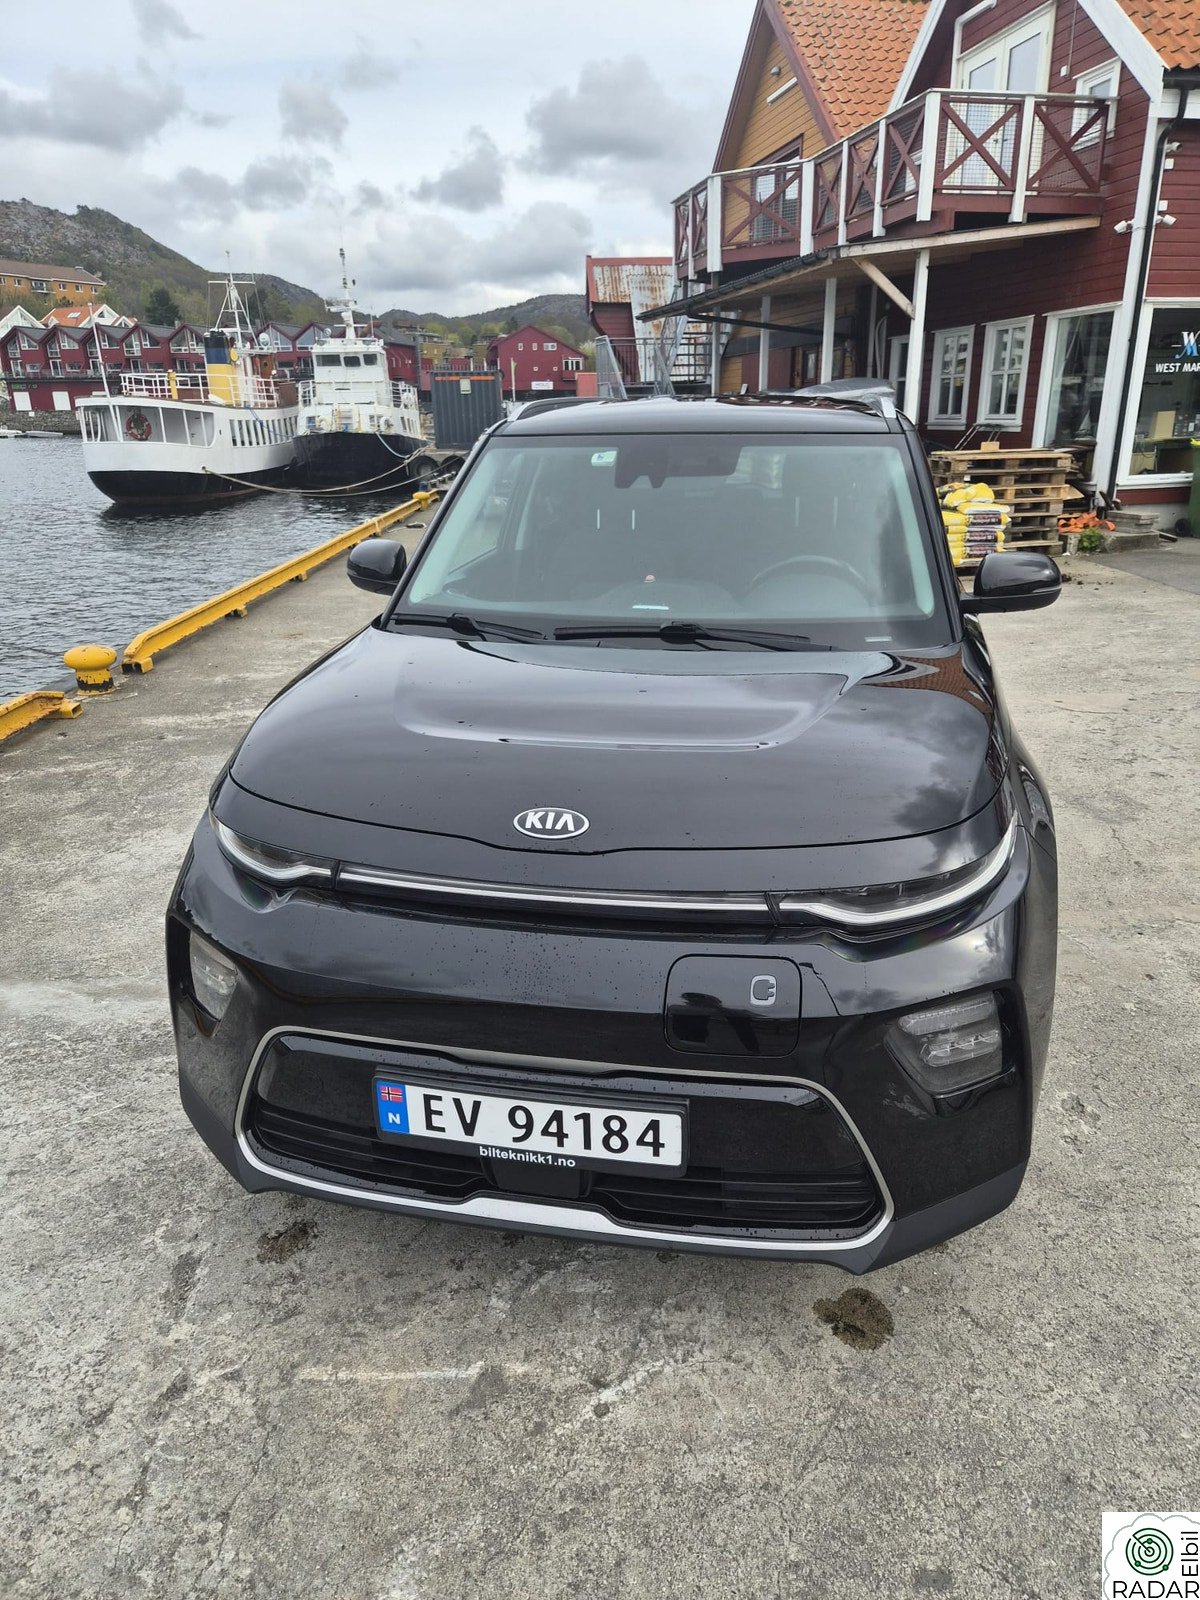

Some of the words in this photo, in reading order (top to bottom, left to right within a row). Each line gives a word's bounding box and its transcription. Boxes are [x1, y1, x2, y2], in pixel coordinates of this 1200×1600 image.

[1155, 363, 1181, 373] WEST
[525, 811, 575, 832] KIA
[387, 1112, 401, 1125] N
[422, 1093, 482, 1137] EV
[507, 1104, 665, 1158] 94184
[479, 1145, 577, 1168] bilteknikk1.no
